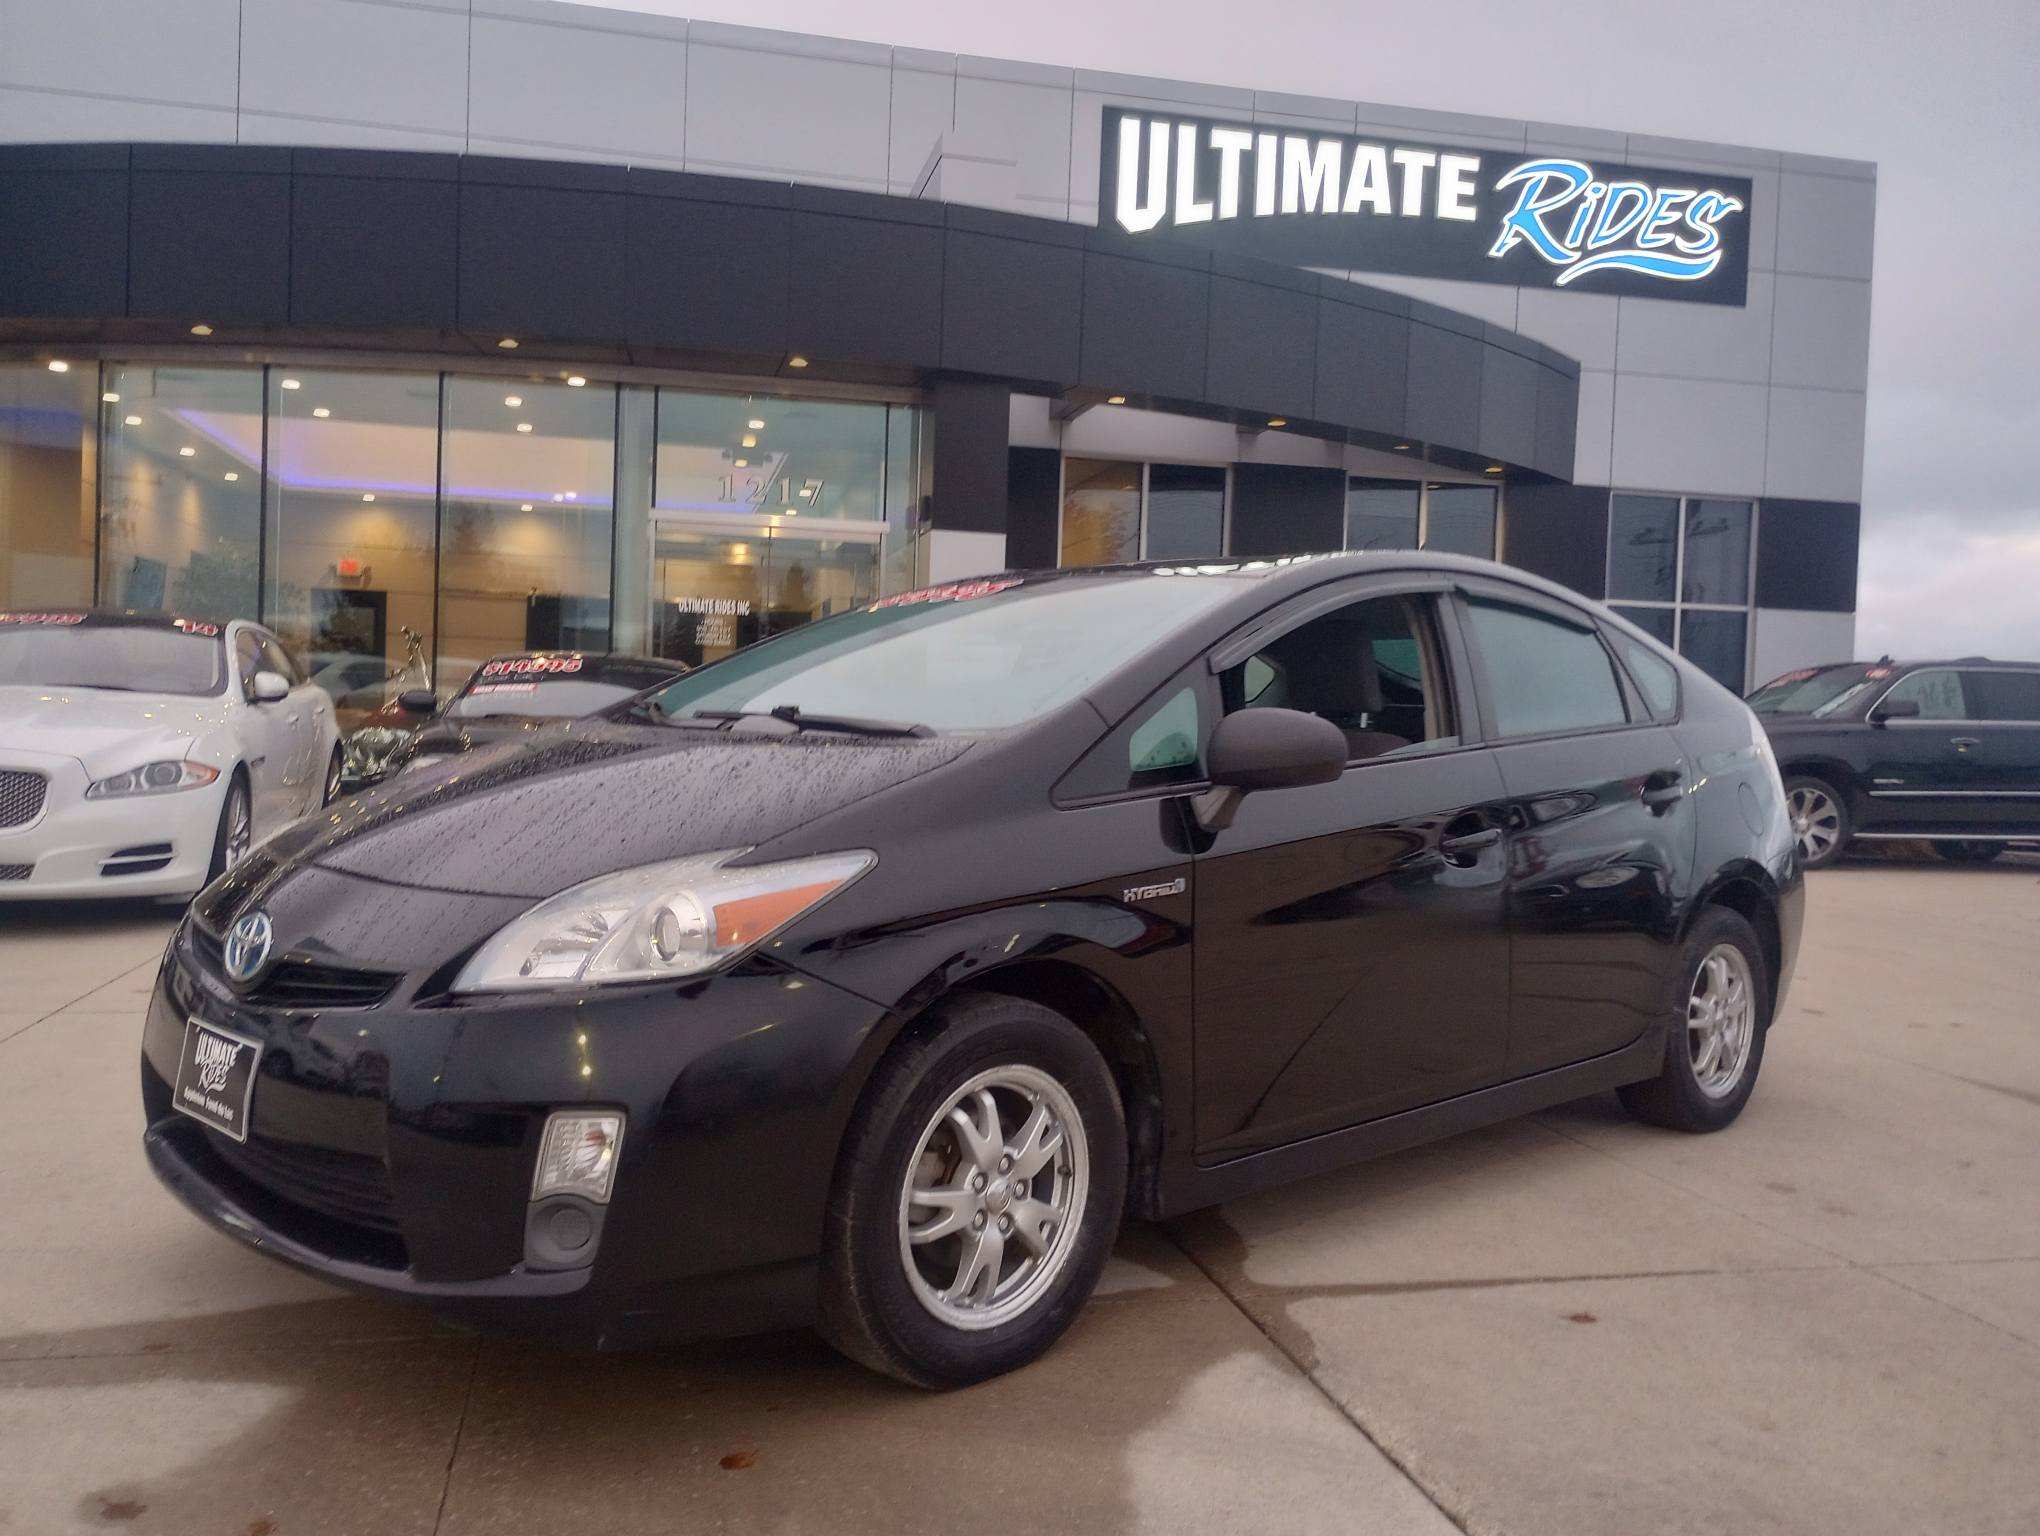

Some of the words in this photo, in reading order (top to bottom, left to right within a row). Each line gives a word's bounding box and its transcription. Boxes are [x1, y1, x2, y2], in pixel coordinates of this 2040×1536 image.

[1115, 114, 1480, 235] ULTIMATE
[718, 473, 825, 508] 1217
[678, 597, 714, 614] ULTIMATE
[714, 599, 737, 616] RIDES
[737, 600, 751, 616] INC
[194, 1032, 236, 1066] ULTIMATE
